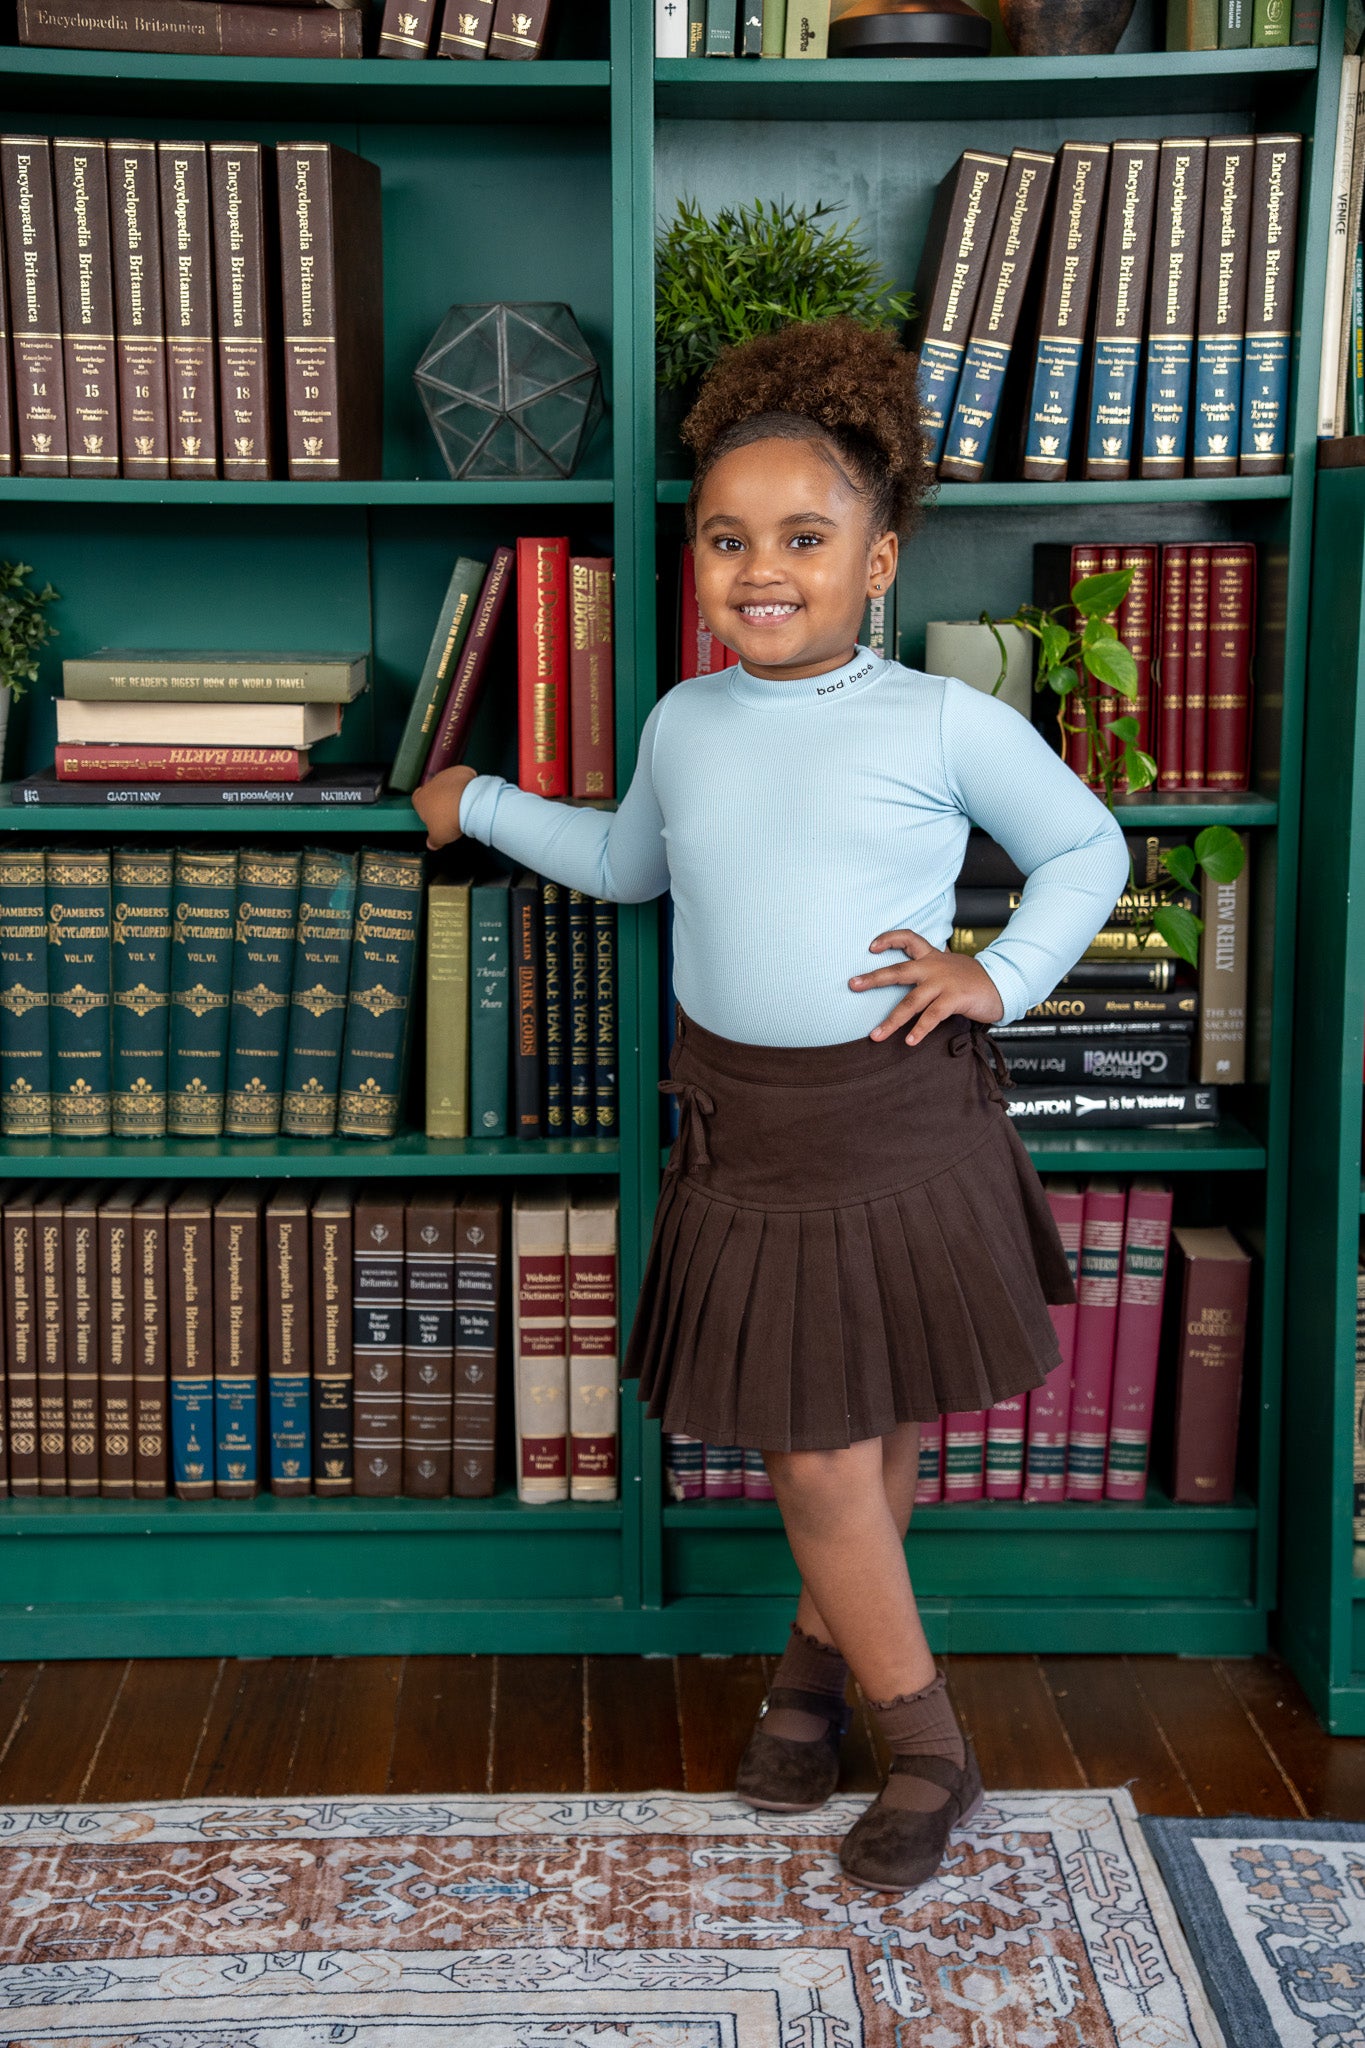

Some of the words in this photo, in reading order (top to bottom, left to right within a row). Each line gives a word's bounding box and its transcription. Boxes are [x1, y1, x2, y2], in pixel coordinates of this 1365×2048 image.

[1335, 193, 1349, 236] VENICE
[24, 251, 41, 324] Britannica
[79, 253, 95, 325] Britannica
[129, 255, 146, 327] Britannica
[178, 256, 194, 327] Britannica
[231, 256, 246, 328] Britannica
[300, 256, 315, 327] Britannica
[942, 262, 970, 332] Britannica
[988, 261, 1017, 331] Britannica
[1057, 255, 1080, 327] Britannica
[1115, 255, 1135, 328] Britannica
[1166, 252, 1184, 325] Britannica
[1217, 252, 1235, 325] Britannica
[1263, 249, 1281, 322] Britannica
[1356, 315, 1363, 328] OF
[1356, 329, 1364, 351] IRISH
[32, 383, 47, 396] 14
[84, 384, 100, 398] 15
[135, 385, 149, 398] 16
[182, 386, 196, 399] 17
[236, 386, 250, 399] 18
[304, 386, 319, 399] 19
[975, 393, 982, 401] V
[1049, 391, 1059, 400] VI
[1160, 389, 1176, 398] VIII
[1262, 386, 1269, 395] X
[537, 545, 559, 584] Len
[475, 595, 497, 638] TOLSTAYA
[573, 565, 589, 650] SHADOWS
[534, 588, 558, 677] Deighton
[110, 677, 126, 688] THE
[129, 677, 169, 688] READER'S
[171, 677, 200, 688] DIGEST
[203, 677, 225, 688] BOOK
[228, 677, 239, 688] OF
[242, 677, 272, 688] WORLD
[275, 677, 306, 689] TRAVEL
[817, 680, 844, 697] bad
[850, 664, 874, 684] bebe
[169, 749, 229, 765] EARTH
[231, 749, 268, 765] THE
[107, 792, 139, 801] LLOYD
[139, 792, 161, 801] ANN
[239, 790, 286, 802] Hollywood
[286, 792, 294, 801] A
[321, 791, 362, 801] MARILYN
[1215, 923, 1236, 973] REILLY
[546, 931, 559, 1000] SCIENCE
[572, 931, 589, 1000] SCIENCE
[597, 931, 612, 1000] SCIENCE
[521, 969, 535, 1007] DARK
[480, 999, 502, 1009] Years
[1206, 1008, 1226, 1018] THE
[521, 1014, 537, 1054] GODS
[548, 1004, 560, 1043] YEAR
[574, 1003, 588, 1043] YEAR
[599, 1003, 613, 1043] YEAR
[1205, 1019, 1244, 1030] SACRED
[1204, 1031, 1244, 1042] STONES
[1040, 1058, 1066, 1072] Port
[1084, 1050, 1168, 1073] Cornwell
[1109, 1097, 1120, 1110] is
[1120, 1096, 1137, 1110] for
[1136, 1094, 1186, 1111] Yesterday
[14, 1226, 28, 1274] Science
[44, 1226, 58, 1274] Science
[76, 1226, 90, 1275] Science
[110, 1227, 125, 1275] Science
[143, 1228, 158, 1275] Science
[15, 1275, 29, 1299] and
[45, 1275, 59, 1300] and
[76, 1276, 90, 1300] and
[111, 1275, 125, 1300] and
[144, 1276, 158, 1301] and
[15, 1300, 29, 1321] the
[45, 1301, 59, 1322] the
[77, 1301, 91, 1321] the
[111, 1301, 125, 1322] the
[144, 1302, 158, 1323] the
[16, 1323, 30, 1364] Future
[46, 1323, 60, 1364] Future
[77, 1323, 91, 1365] Future
[111, 1324, 126, 1366] Future
[144, 1324, 158, 1366] Future
[184, 1305, 199, 1368] Britannica
[230, 1305, 243, 1367] Britannica
[373, 1332, 387, 1342] 19
[421, 1333, 437, 1344] 20
[70, 1422, 96, 1431] BOOK
[71, 1413, 95, 1421] YEAR
